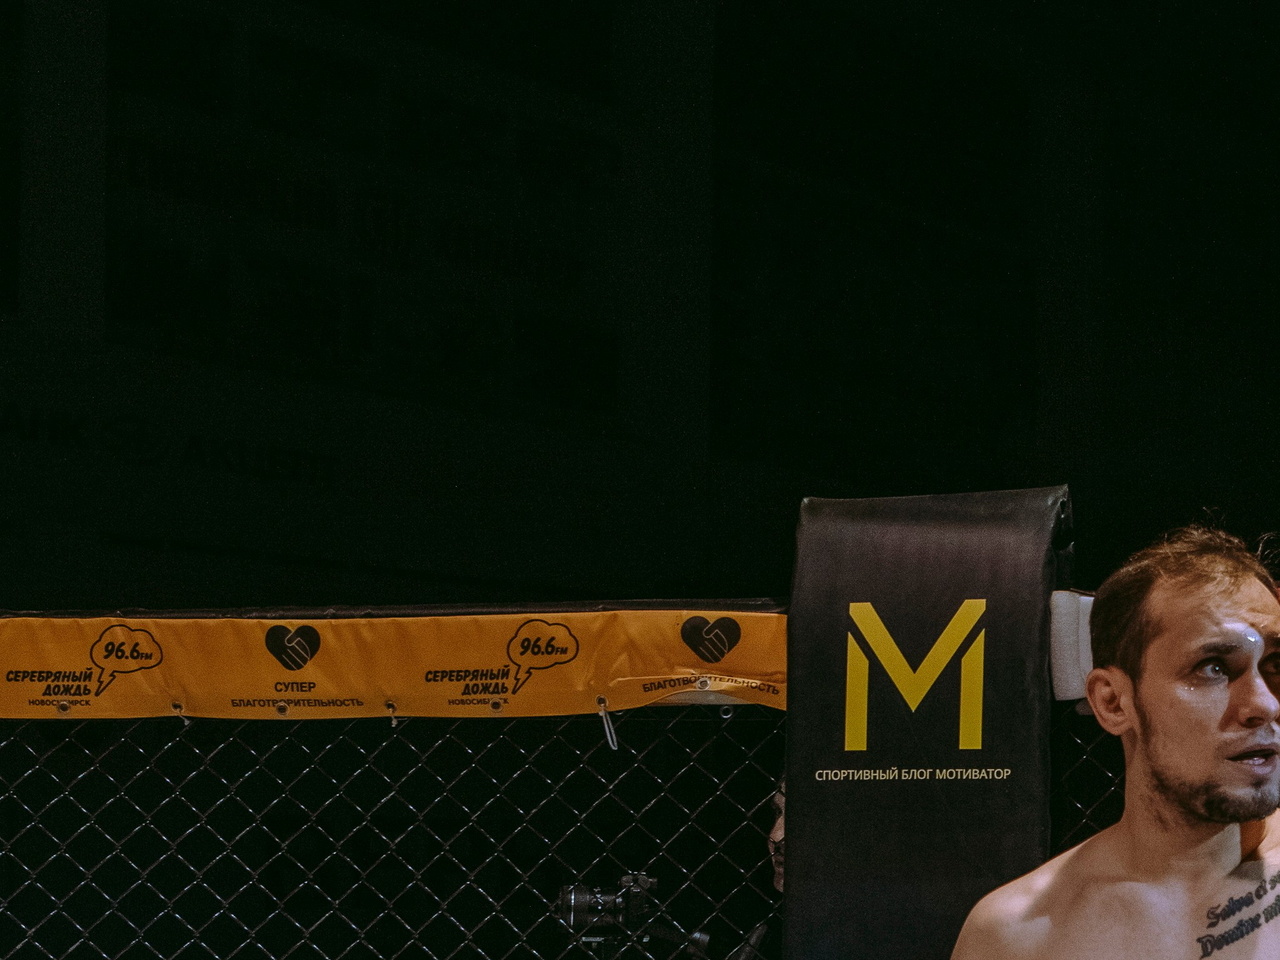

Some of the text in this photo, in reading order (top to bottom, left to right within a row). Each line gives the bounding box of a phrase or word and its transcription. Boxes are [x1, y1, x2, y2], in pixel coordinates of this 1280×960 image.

[6, 667, 94, 682] СЕРЕБРЯНЫЙ
[425, 664, 511, 682] СЕРЕБРЯНЫЙ
[42, 684, 91, 696] ДОЖДЬ
[274, 682, 316, 692] СУПЕР
[461, 682, 509, 696] ДОЖДЬ
[448, 697, 509, 705] НОВОСИБК
[815, 767, 1011, 781] СПОРТИВНЫЙ БЛОГ МОТИВАТОР
